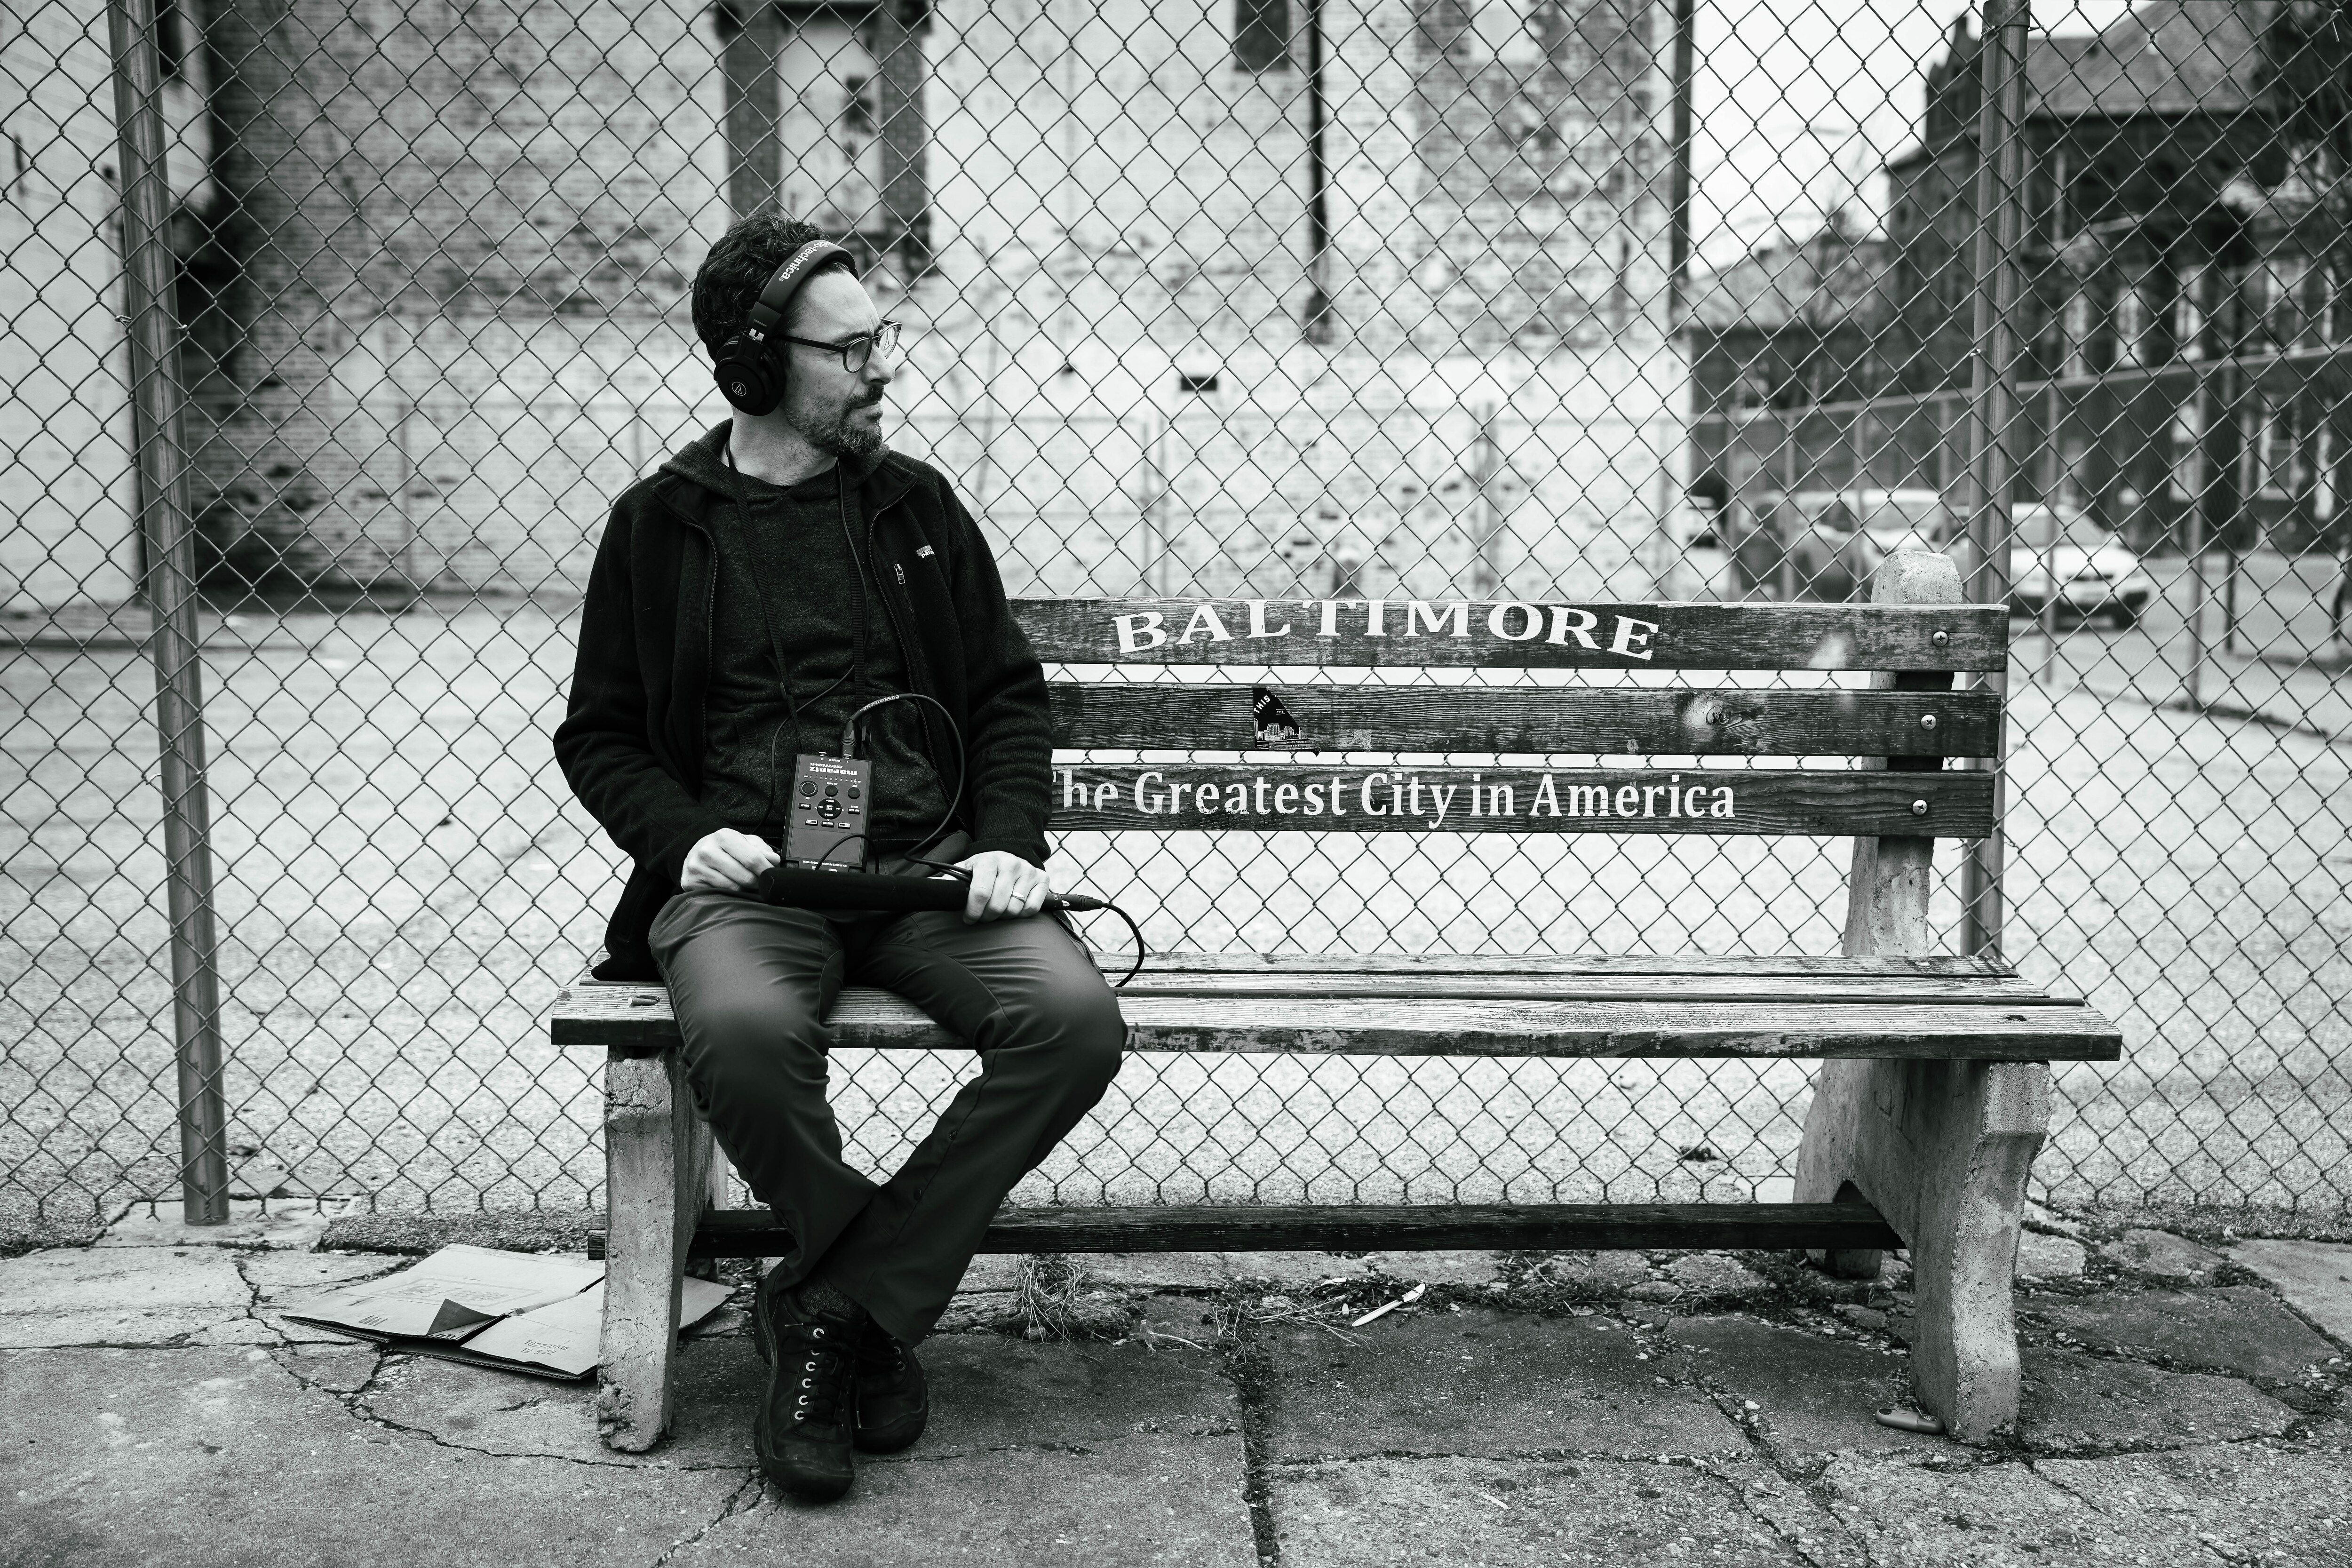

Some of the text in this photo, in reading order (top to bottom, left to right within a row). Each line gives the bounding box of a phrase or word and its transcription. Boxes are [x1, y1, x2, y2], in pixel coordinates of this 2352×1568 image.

[1112, 601, 1659, 660] BALTIMORE
[1254, 695, 1271, 714] THIS
[810, 766, 857, 776] marantz
[1053, 769, 1736, 829] he Greatest City in America
